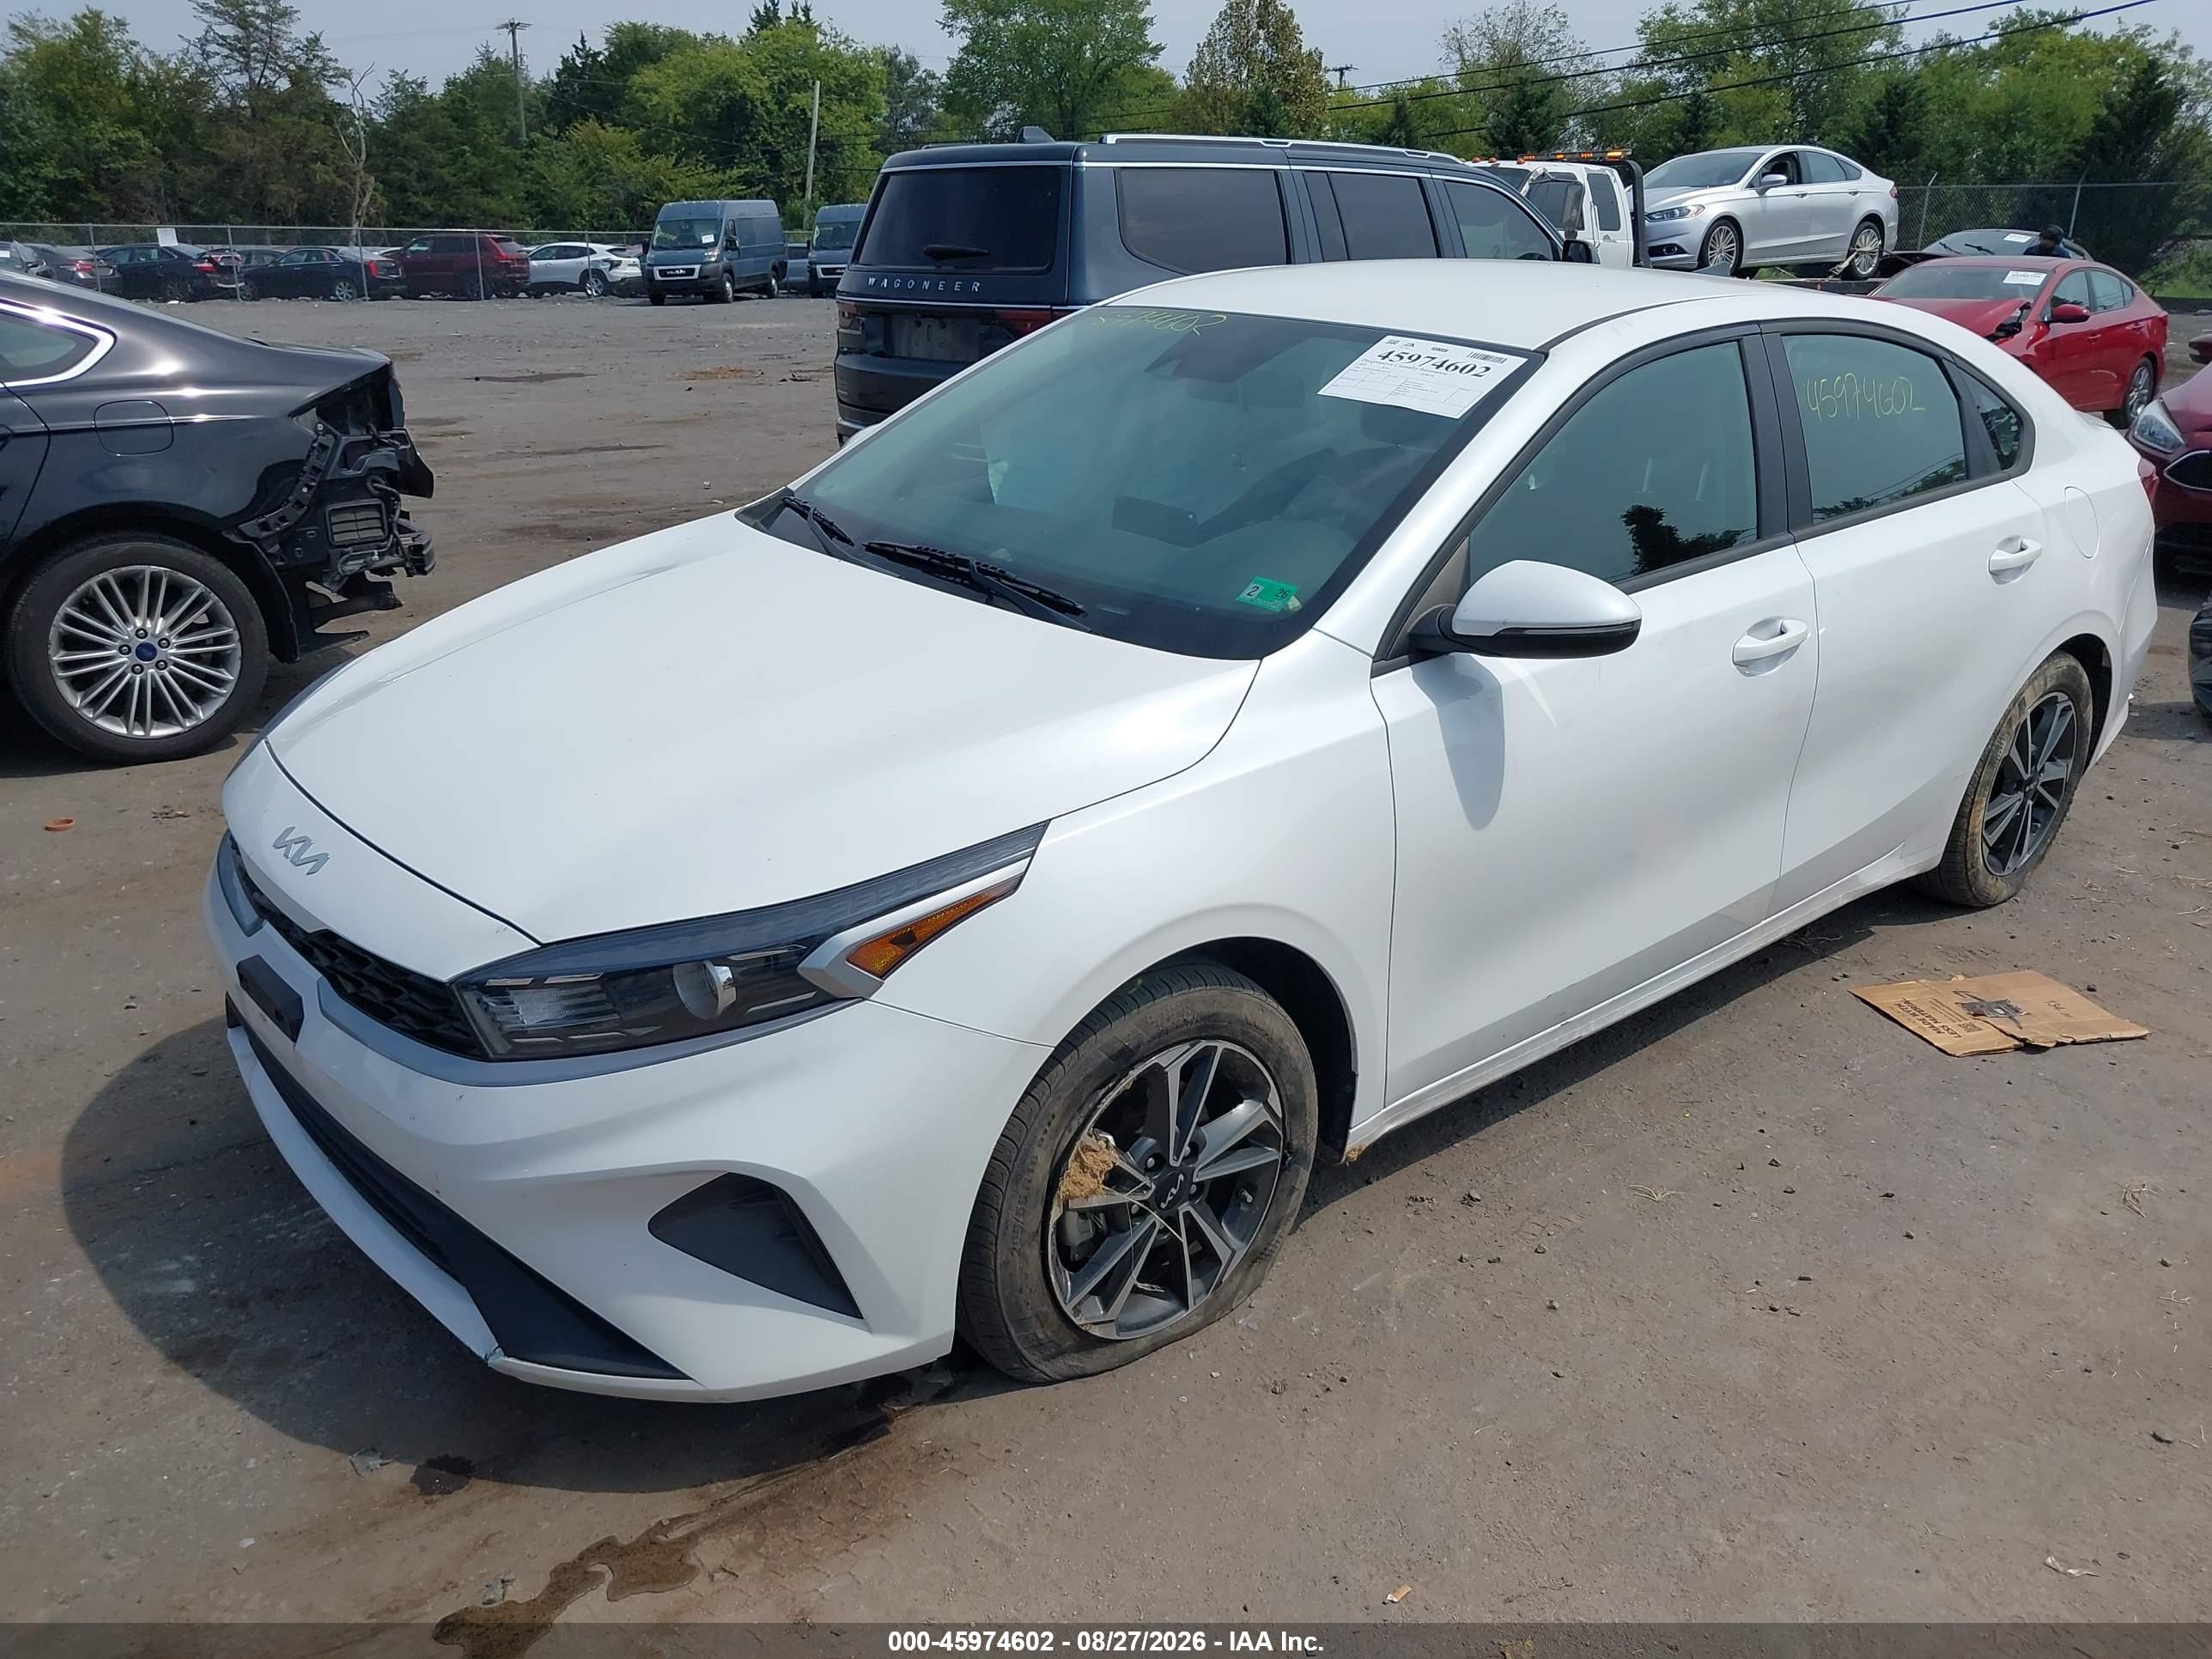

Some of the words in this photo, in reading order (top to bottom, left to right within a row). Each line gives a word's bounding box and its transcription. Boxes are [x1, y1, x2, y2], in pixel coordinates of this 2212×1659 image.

[868, 276, 981, 292] WAGONEER
[1377, 350, 1492, 378] 45974602
[1807, 373, 1926, 422] 45974602
[1246, 586, 1260, 597] 2
[1917, 1017, 1946, 1034] MADE
[1939, 1024, 1963, 1038] LESS
